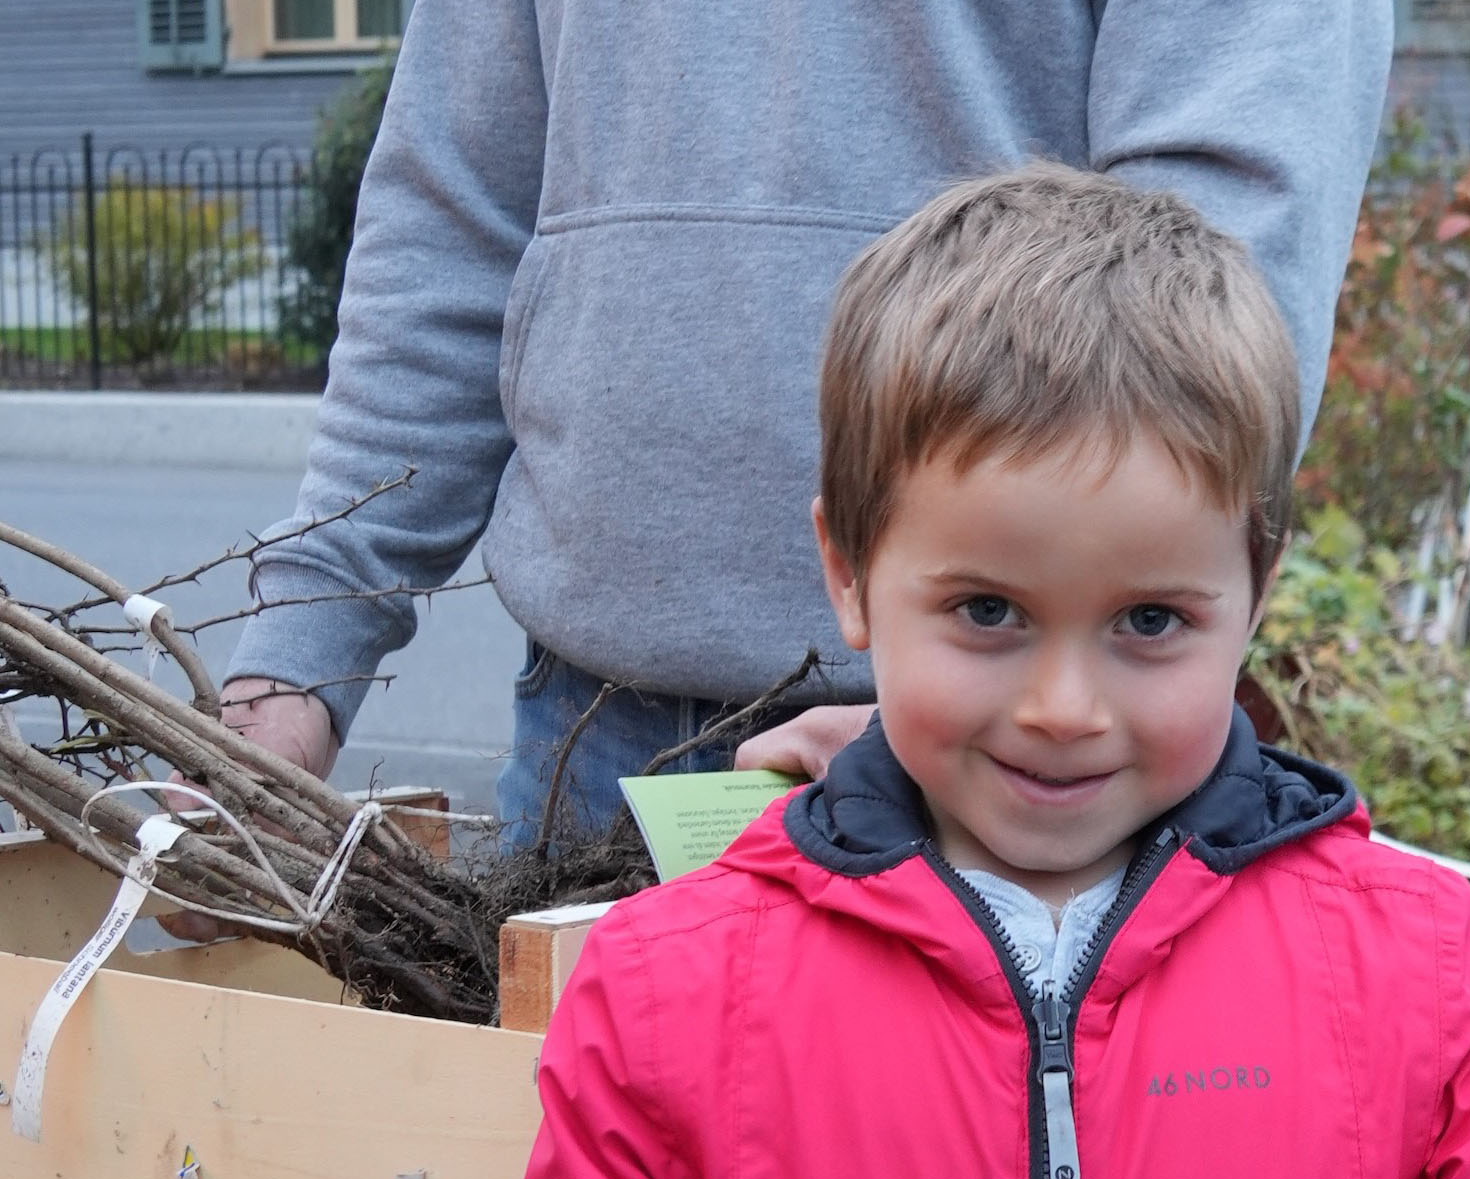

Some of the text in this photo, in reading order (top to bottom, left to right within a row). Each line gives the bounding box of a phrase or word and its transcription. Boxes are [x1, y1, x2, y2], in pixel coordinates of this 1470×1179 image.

[62, 911, 130, 999] Viburnum lantana
[1147, 1066, 1271, 1097] 46 NORD
